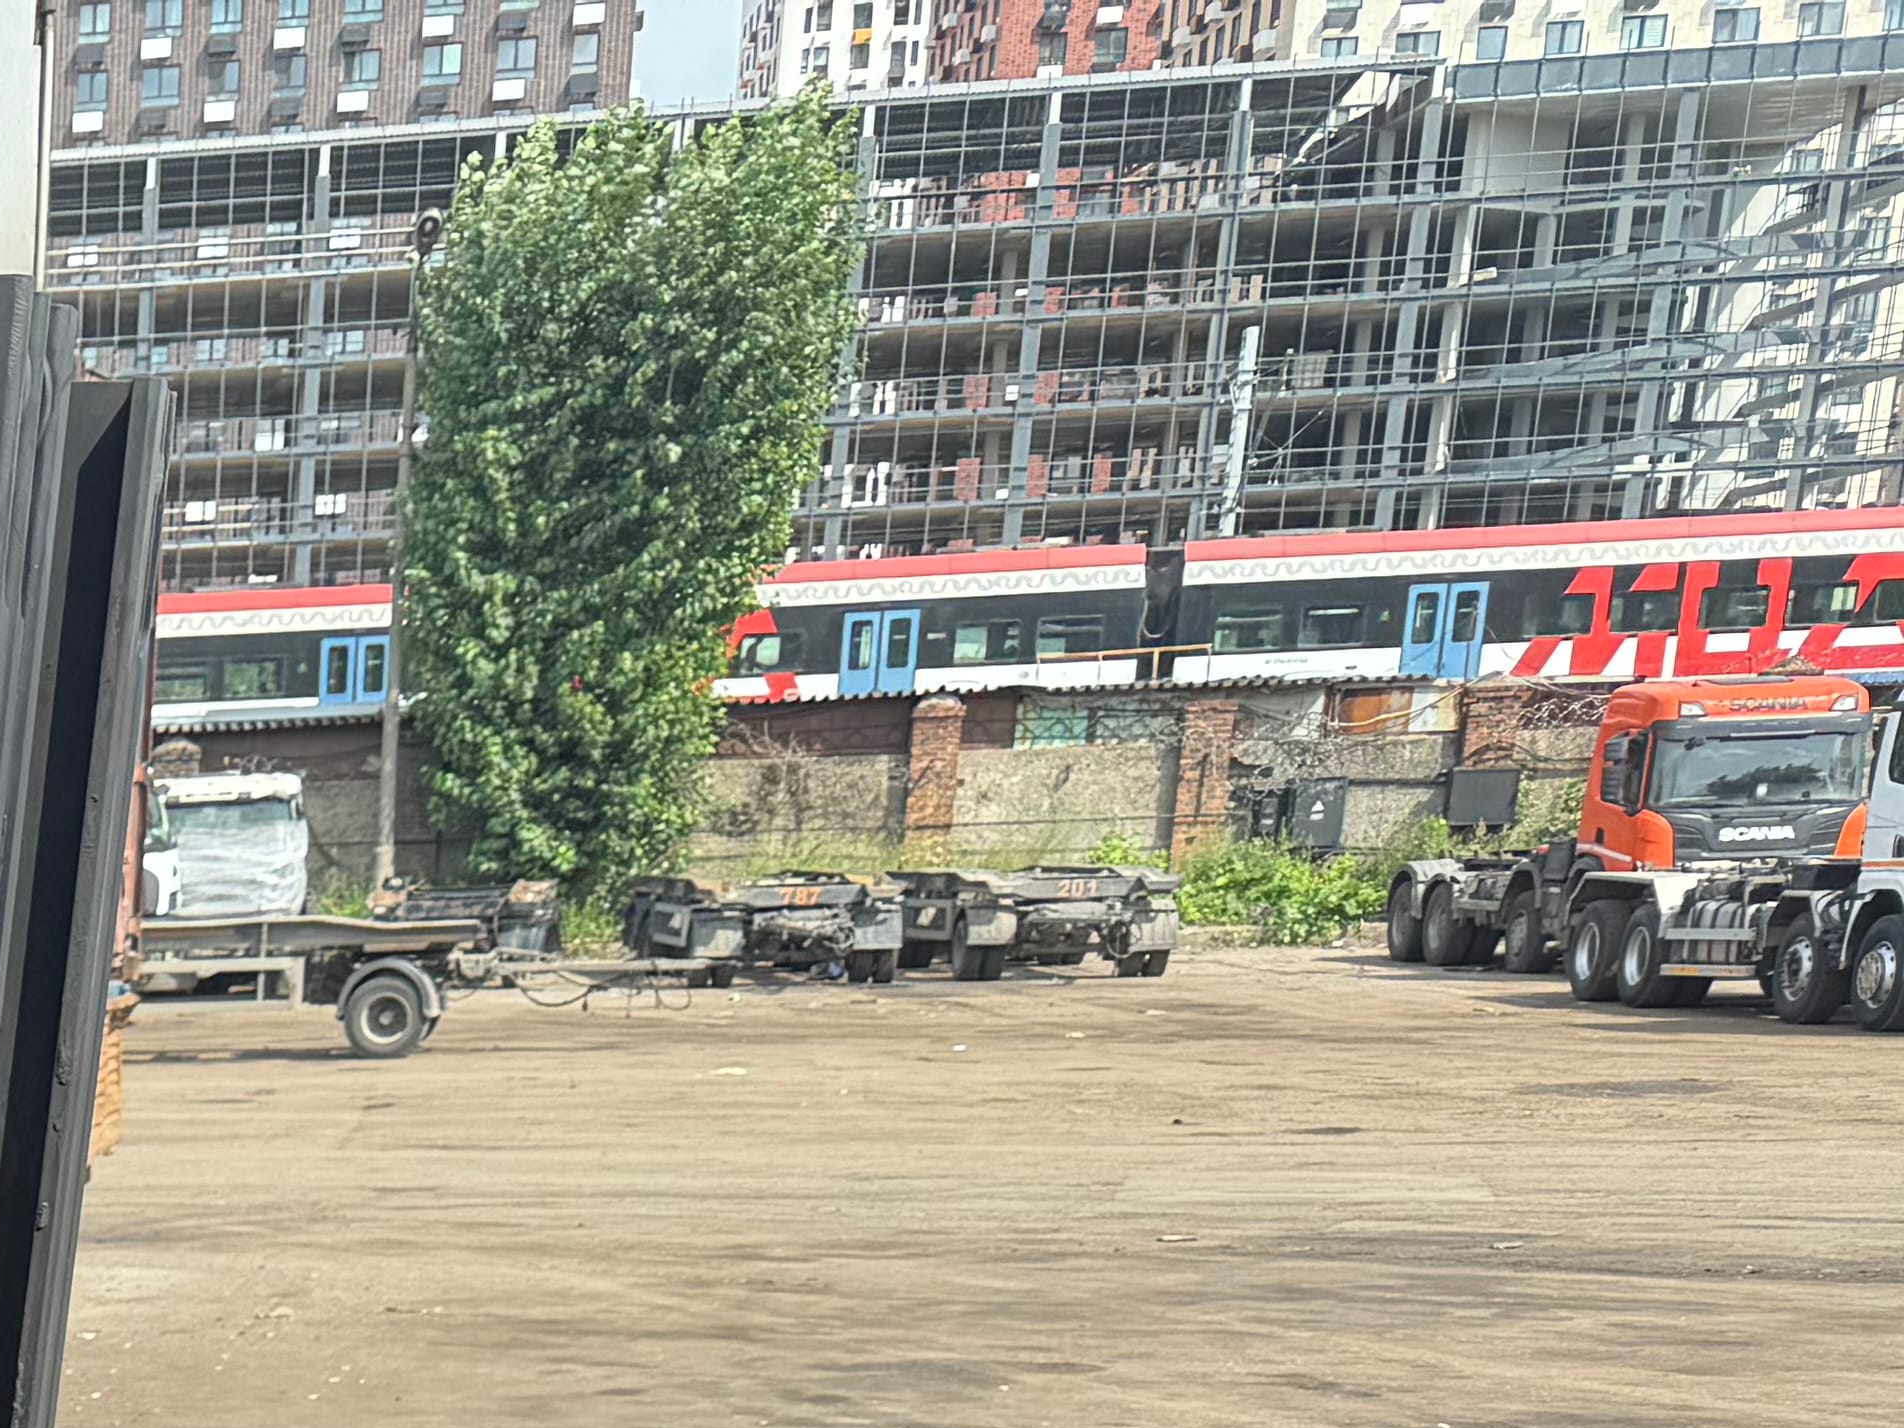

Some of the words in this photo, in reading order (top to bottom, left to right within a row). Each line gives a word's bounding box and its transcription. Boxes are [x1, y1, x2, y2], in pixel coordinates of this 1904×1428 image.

[1729, 697, 1808, 712] SCANIA
[1718, 826, 1796, 842] SCANIA
[779, 886, 823, 906] 787
[1057, 878, 1098, 898] 201
